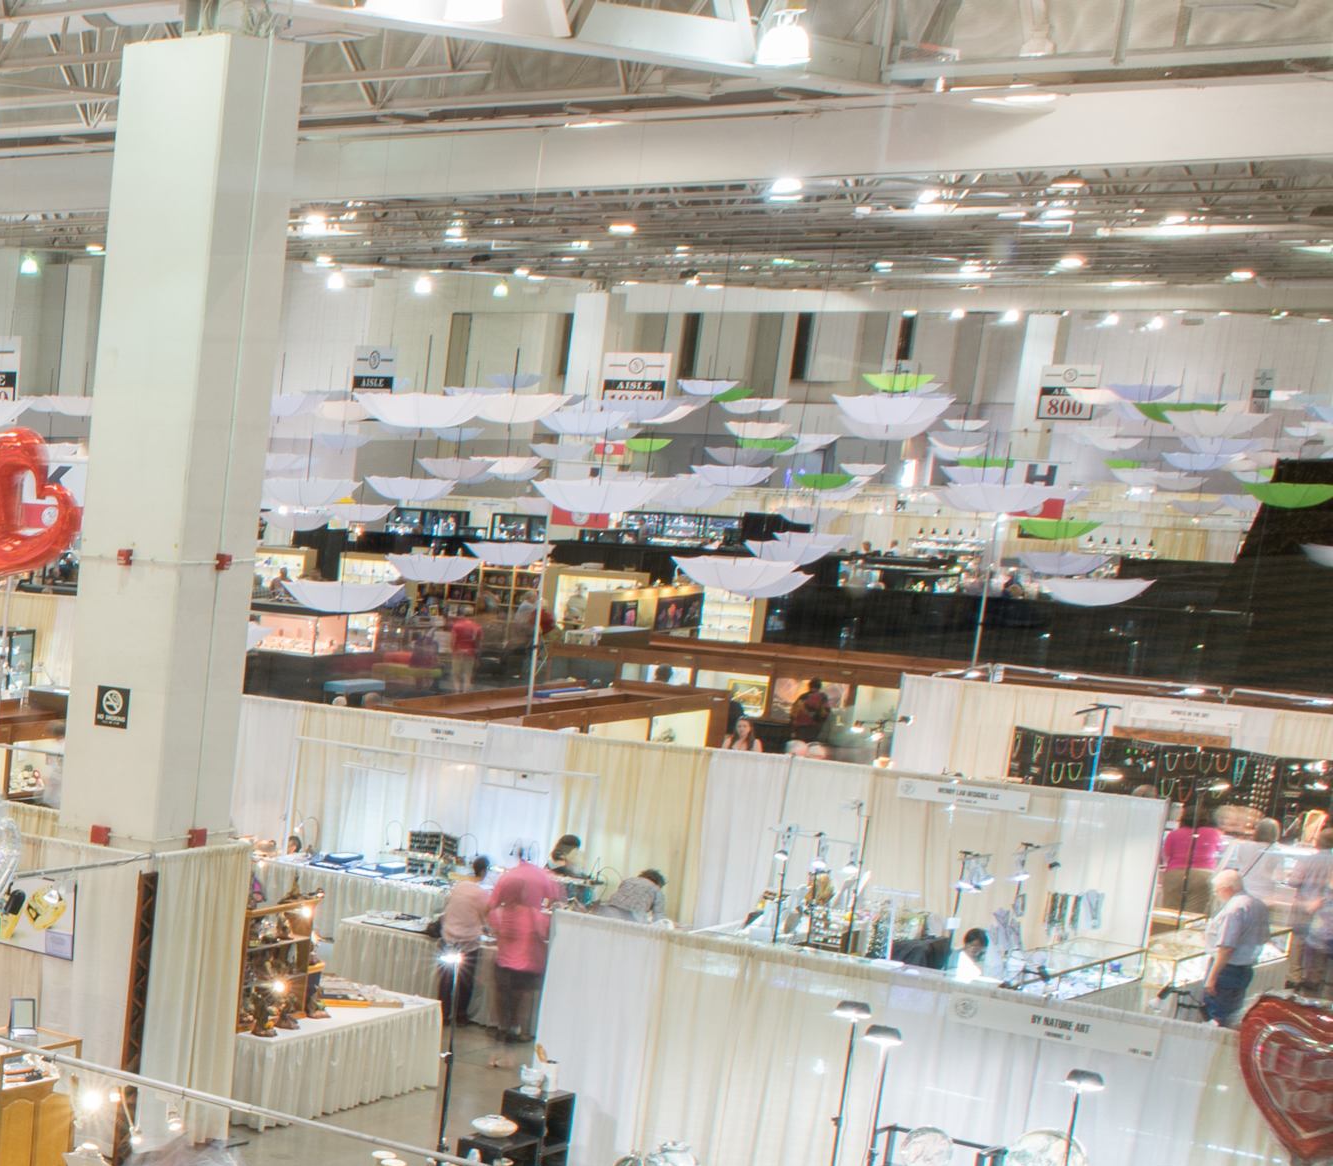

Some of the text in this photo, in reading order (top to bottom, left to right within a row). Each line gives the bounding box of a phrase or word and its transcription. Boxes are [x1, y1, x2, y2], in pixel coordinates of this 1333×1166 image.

[616, 381, 652, 390] AISLE
[1047, 398, 1082, 416] 800
[1031, 1014, 1091, 1034] BY NATURE ART
